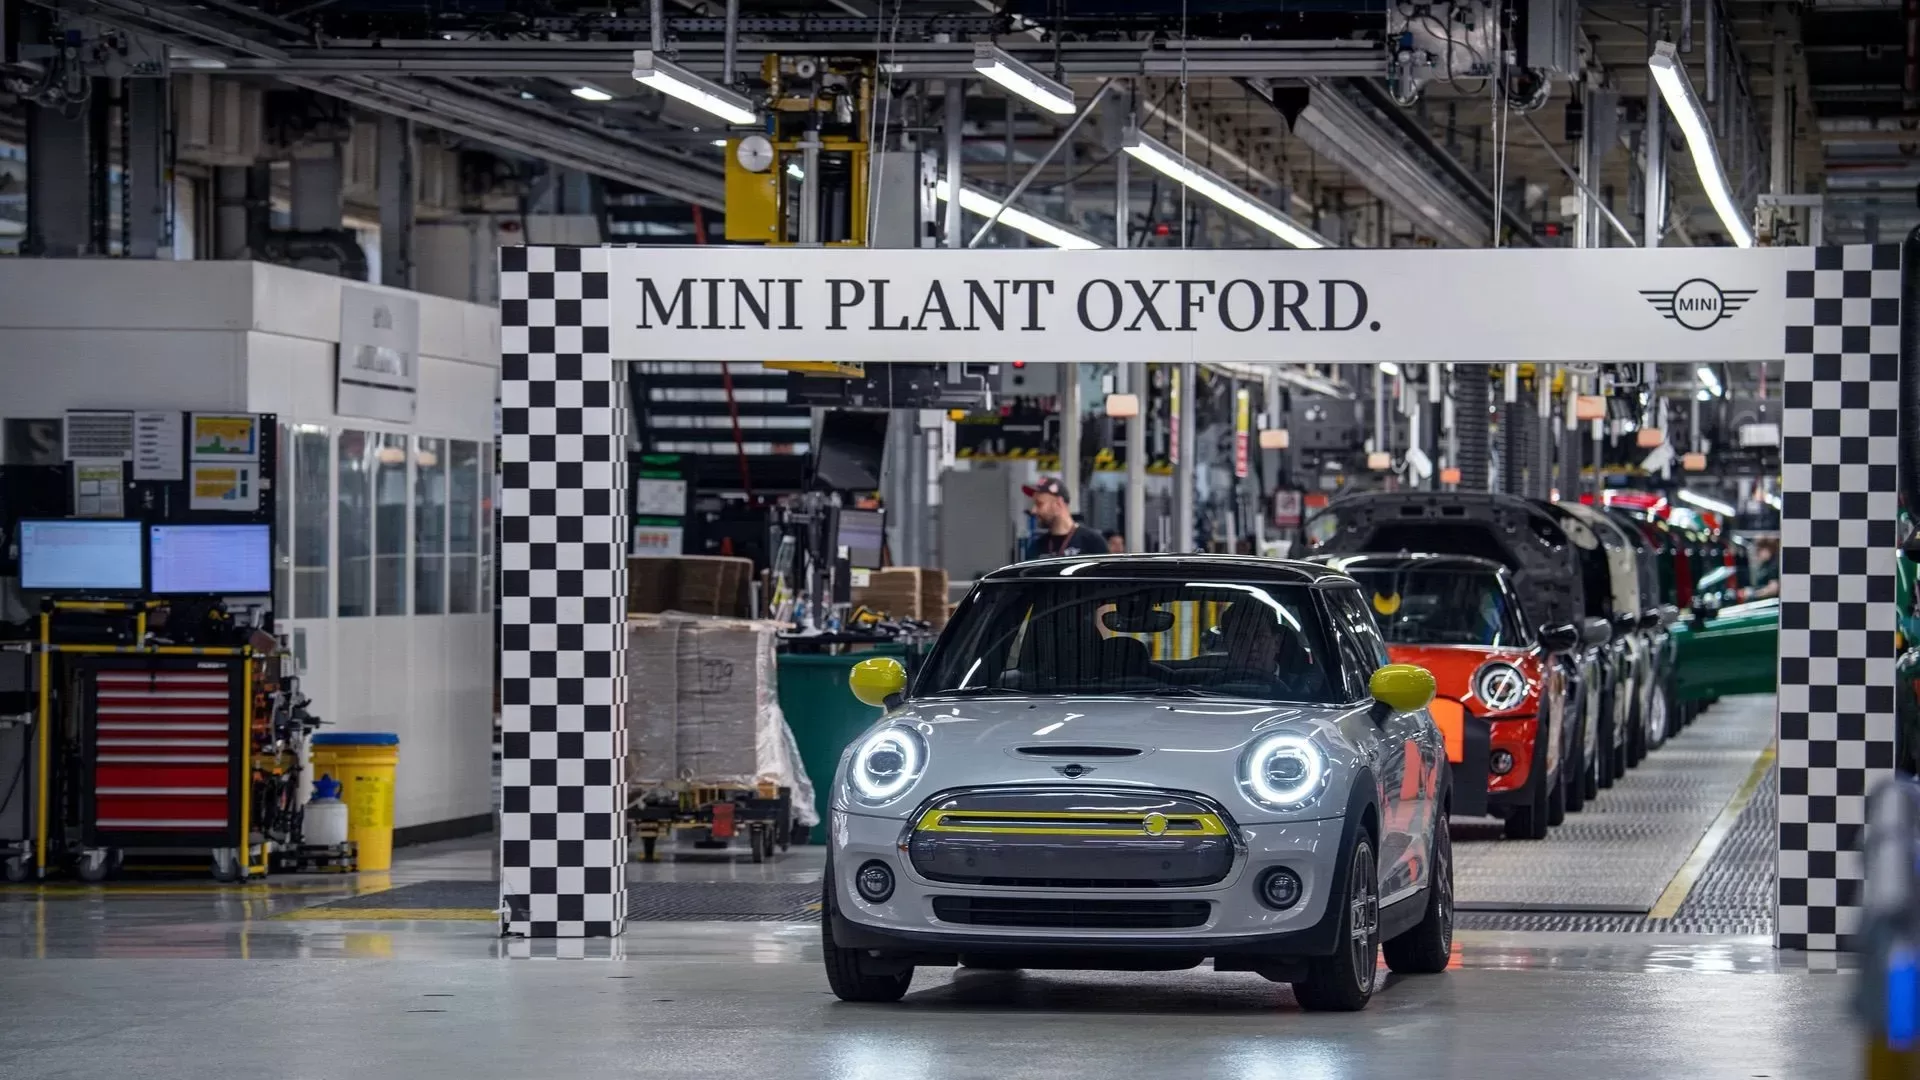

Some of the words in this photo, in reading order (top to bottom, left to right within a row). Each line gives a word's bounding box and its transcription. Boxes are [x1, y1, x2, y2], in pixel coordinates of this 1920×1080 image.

[636, 278, 803, 330] MINI
[826, 279, 1055, 331] PLANT
[1077, 279, 1381, 332] OXFORD.
[1679, 298, 1717, 311] MINI
